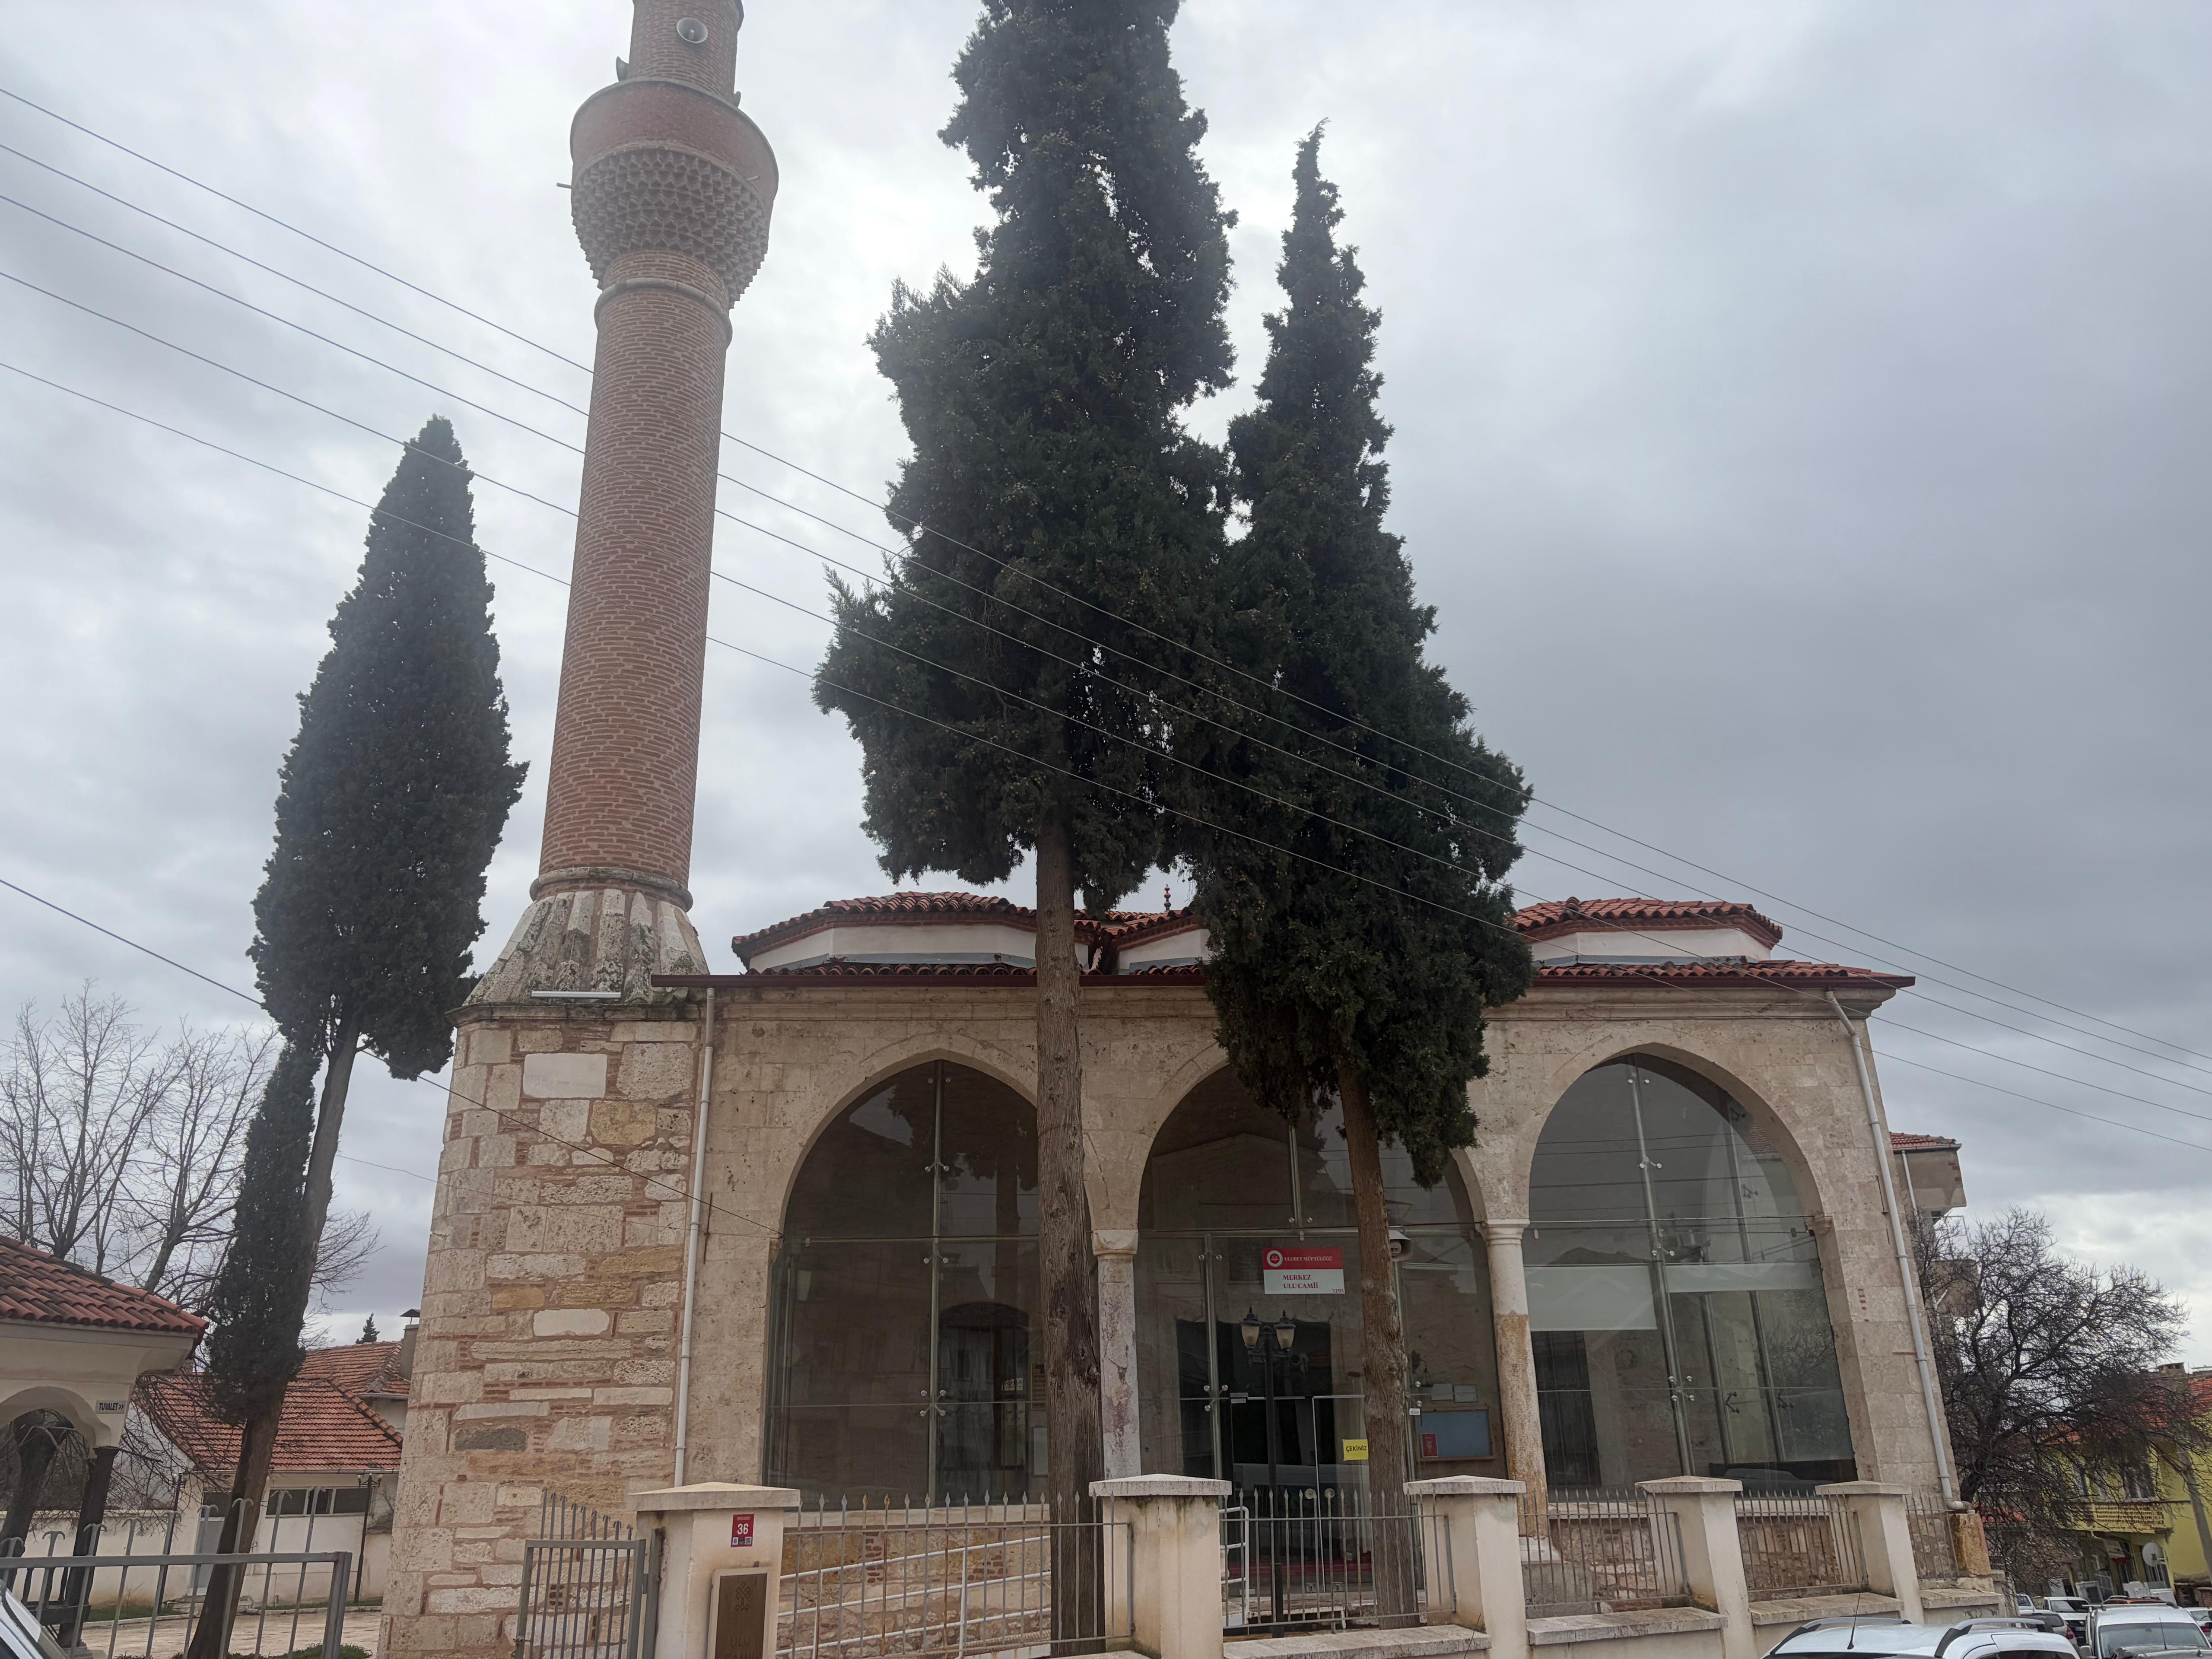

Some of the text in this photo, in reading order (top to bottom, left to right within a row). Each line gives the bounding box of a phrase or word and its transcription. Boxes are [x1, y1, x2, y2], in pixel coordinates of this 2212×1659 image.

[99, 1402, 118, 1411] TUVALET
[737, 1523, 749, 1535] 36
[731, 1636, 750, 1647] ULU
